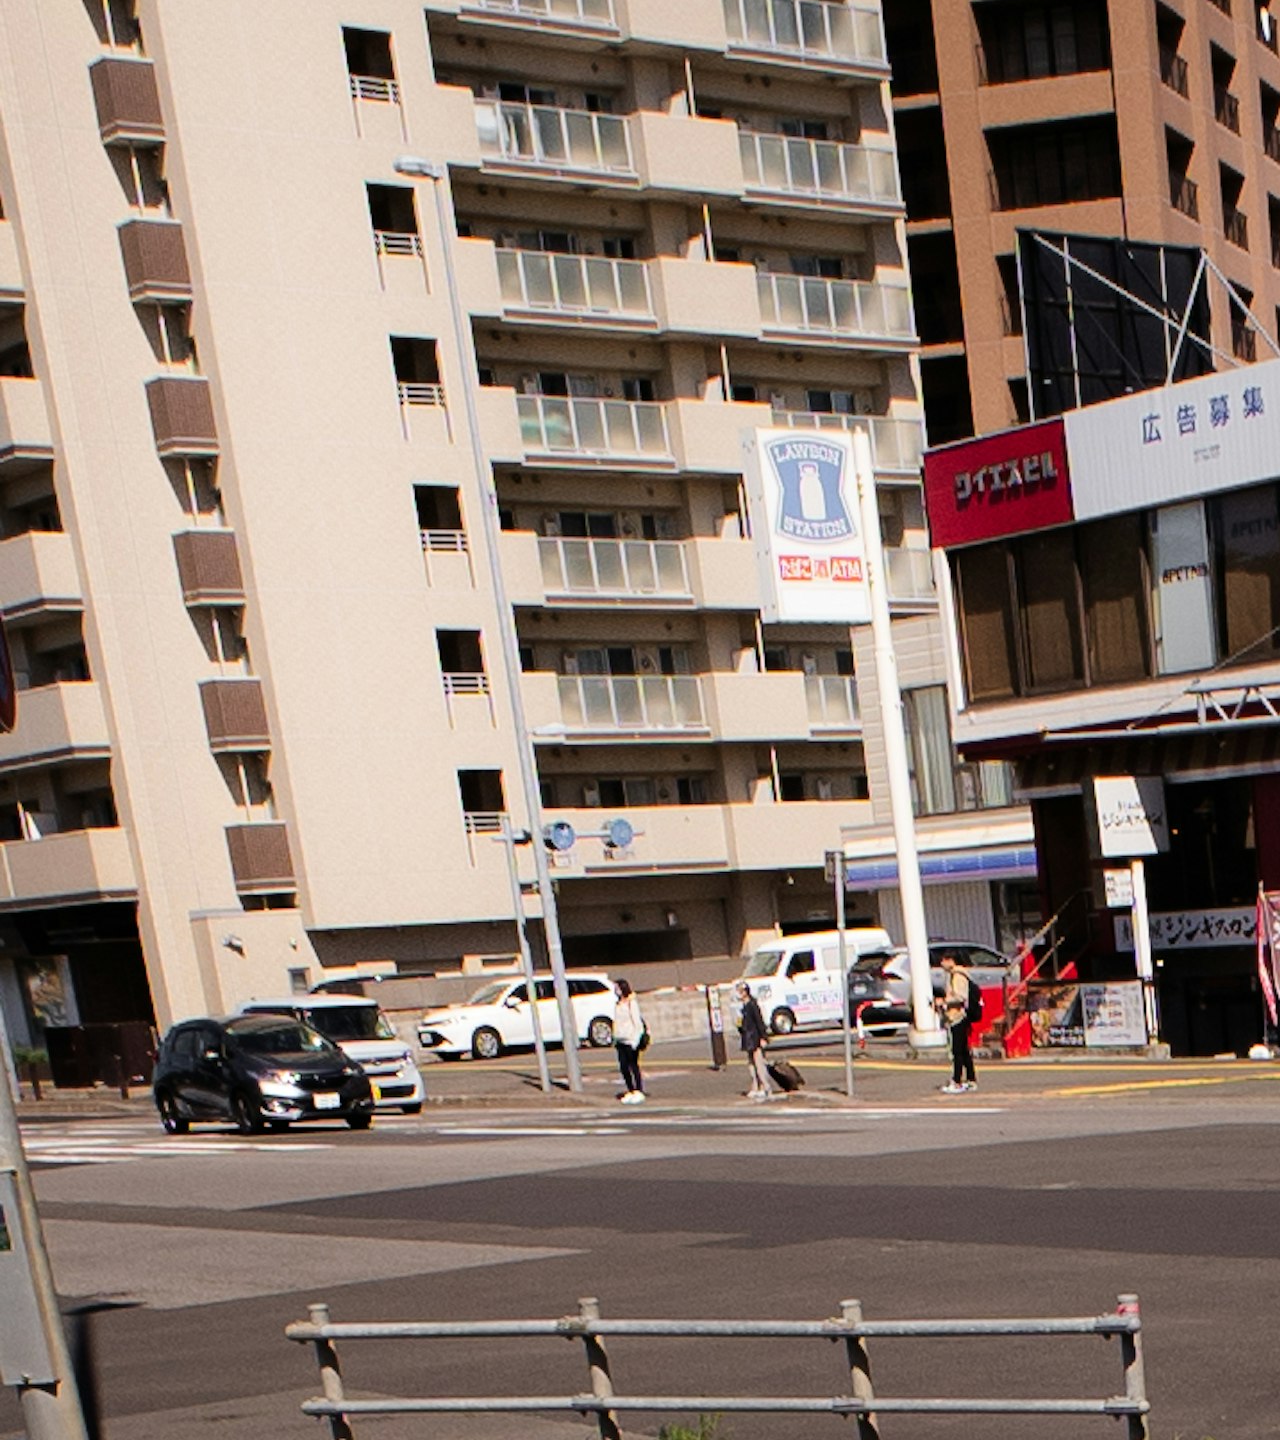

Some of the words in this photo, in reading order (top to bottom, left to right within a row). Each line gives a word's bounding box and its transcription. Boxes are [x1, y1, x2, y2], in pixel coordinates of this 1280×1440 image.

[1141, 386, 1264, 444] 広告募集
[774, 446, 840, 466] LAWSON
[784, 516, 846, 537] STATION
[832, 560, 860, 577] ATM
